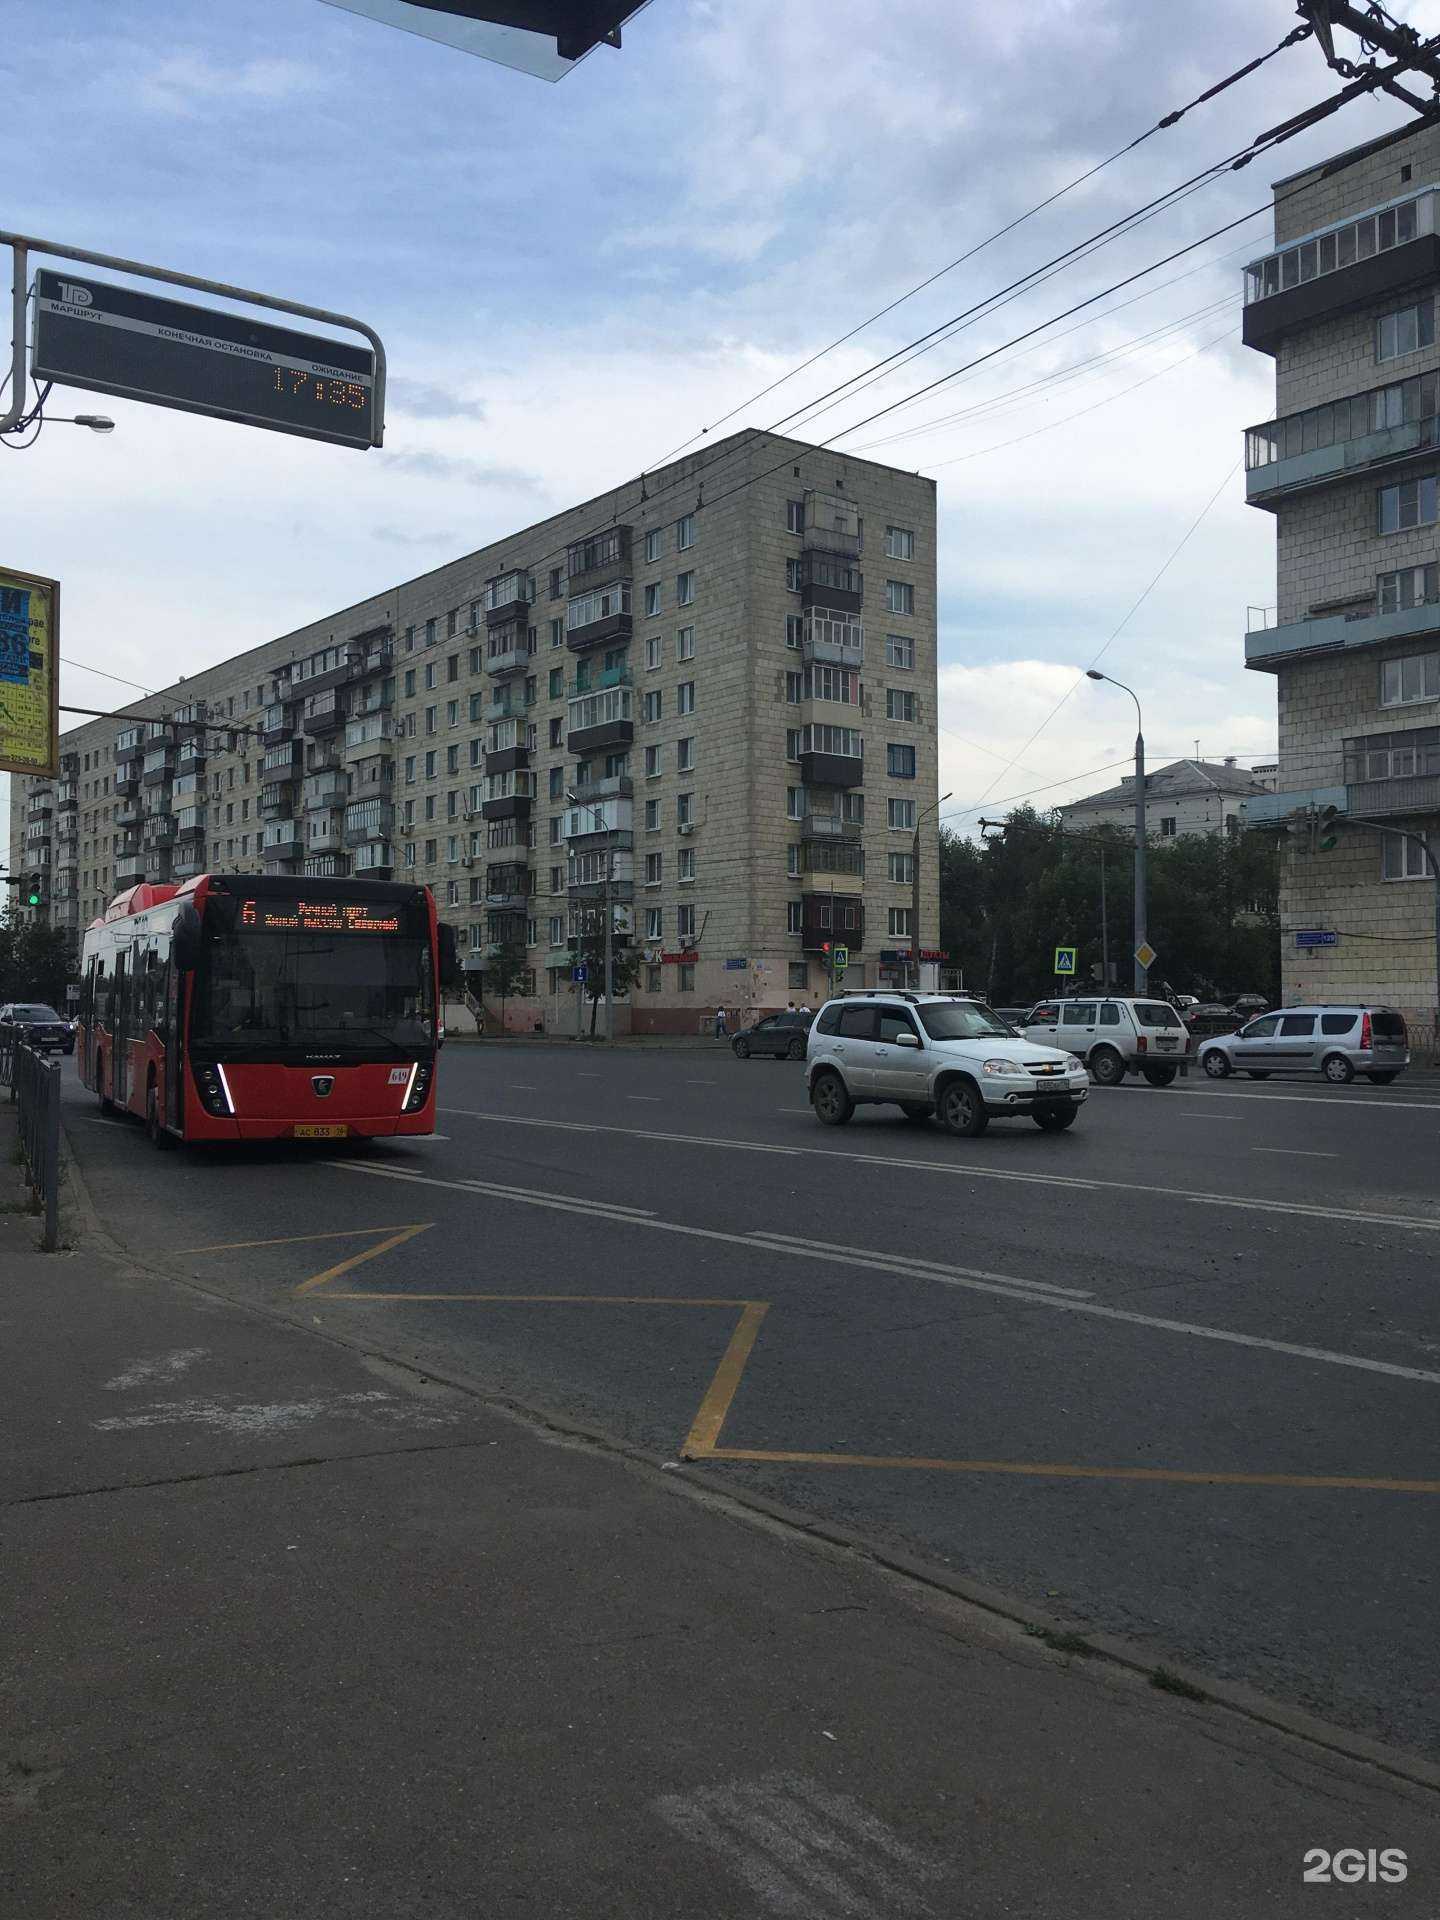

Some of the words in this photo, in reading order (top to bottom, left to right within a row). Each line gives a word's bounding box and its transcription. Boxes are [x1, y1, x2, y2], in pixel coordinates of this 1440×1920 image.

[50, 302, 103, 321] МАРШРУТ
[157, 327, 212, 347] КОНЕЧНАЯ
[214, 342, 273, 361] ОСТАНОВКА
[311, 364, 363, 382] ОЖИДАНИЕ
[274, 367, 366, 408] 17:35
[243, 901, 256, 924] 6
